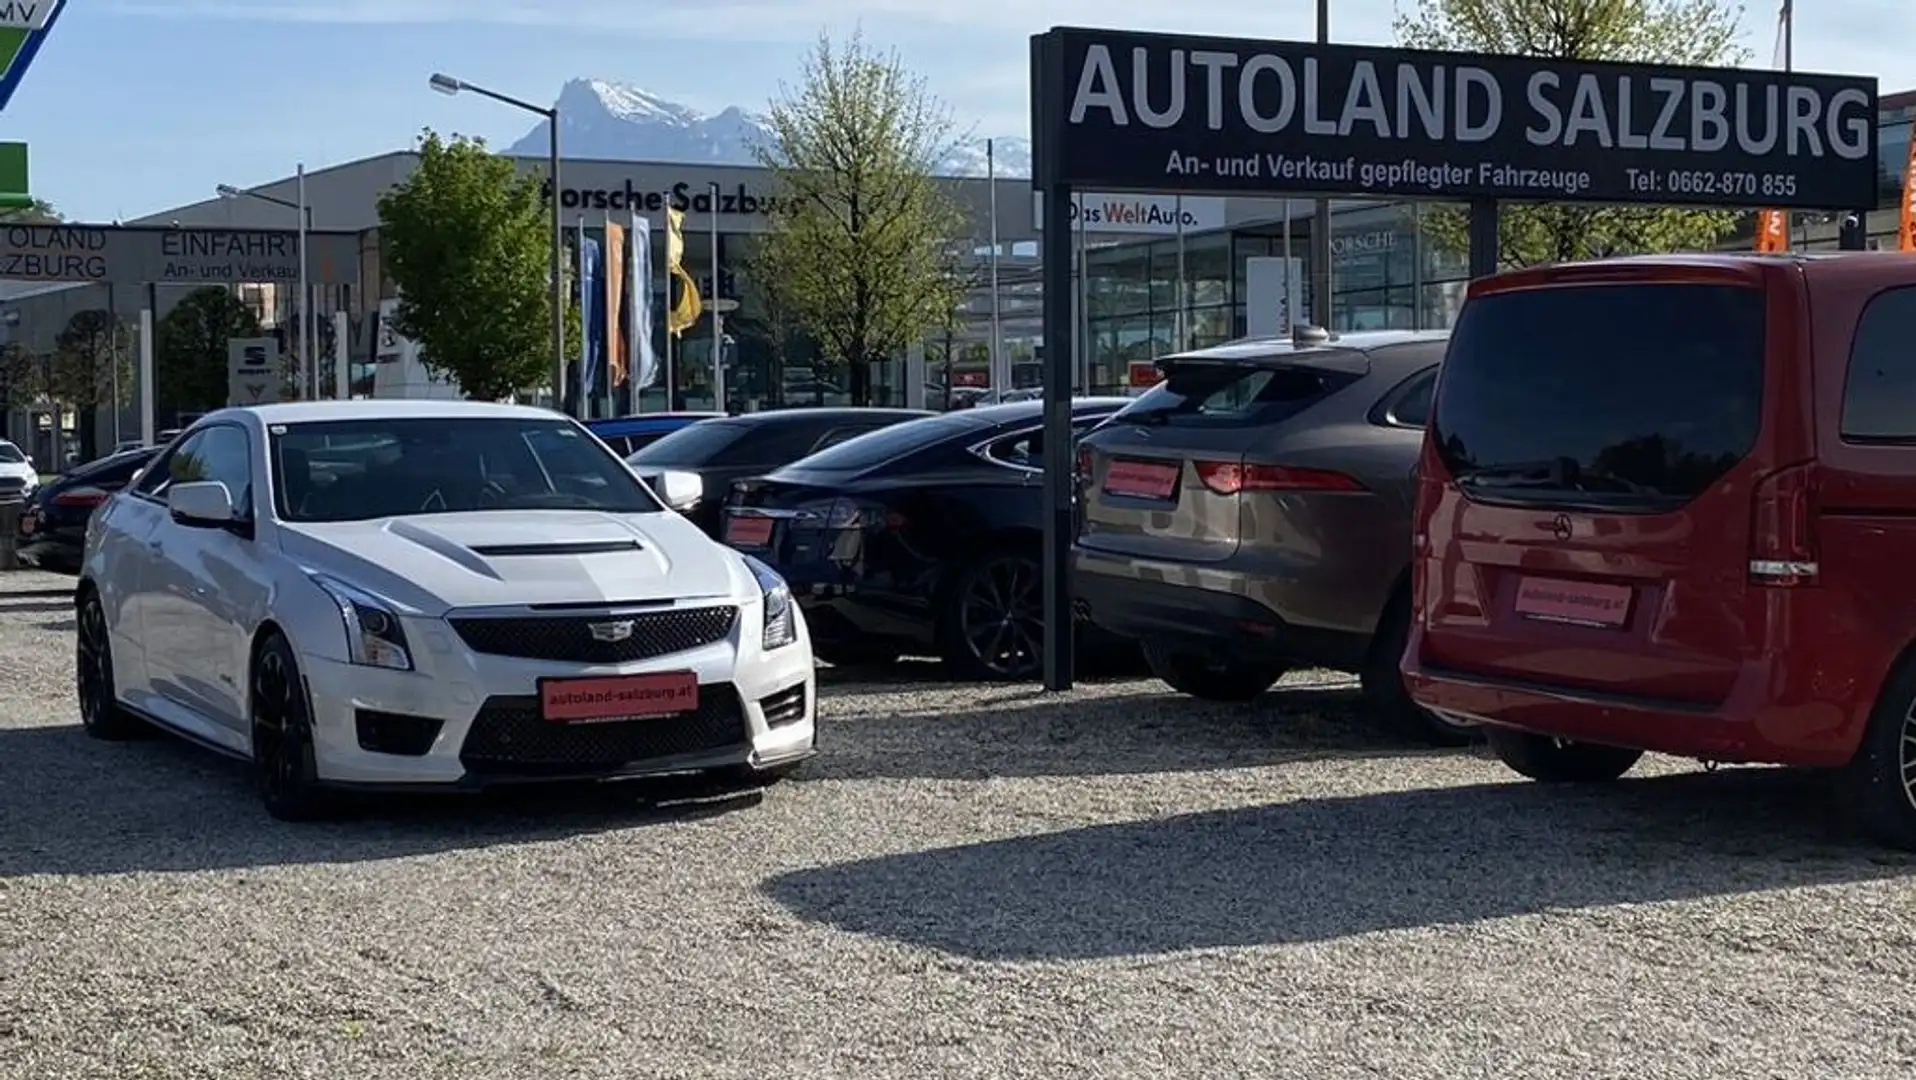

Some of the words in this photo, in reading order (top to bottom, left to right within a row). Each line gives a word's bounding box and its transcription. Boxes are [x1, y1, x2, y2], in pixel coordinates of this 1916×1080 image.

[1069, 44, 1503, 142] AUTOLAND
[1526, 71, 1868, 159] SALZBURG
[1166, 150, 1210, 174] An-
[1216, 153, 1260, 176] und
[1267, 154, 1355, 180] Verkauf
[1360, 160, 1473, 187] gepflegter
[1479, 163, 1590, 194] Fahrzeuge
[1626, 169, 1662, 192] Tel:
[1668, 171, 1756, 195] 0662-870
[1762, 174, 1796, 196] 855
[162, 231, 299, 257] EINFAHRT
[1331, 230, 1397, 255] ORSCHE
[0, 254, 106, 278] ZBURG
[164, 262, 194, 278] An-
[201, 263, 232, 279] und
[238, 263, 298, 280] Verkau
[550, 686, 692, 705] autoland-salzburg.at
